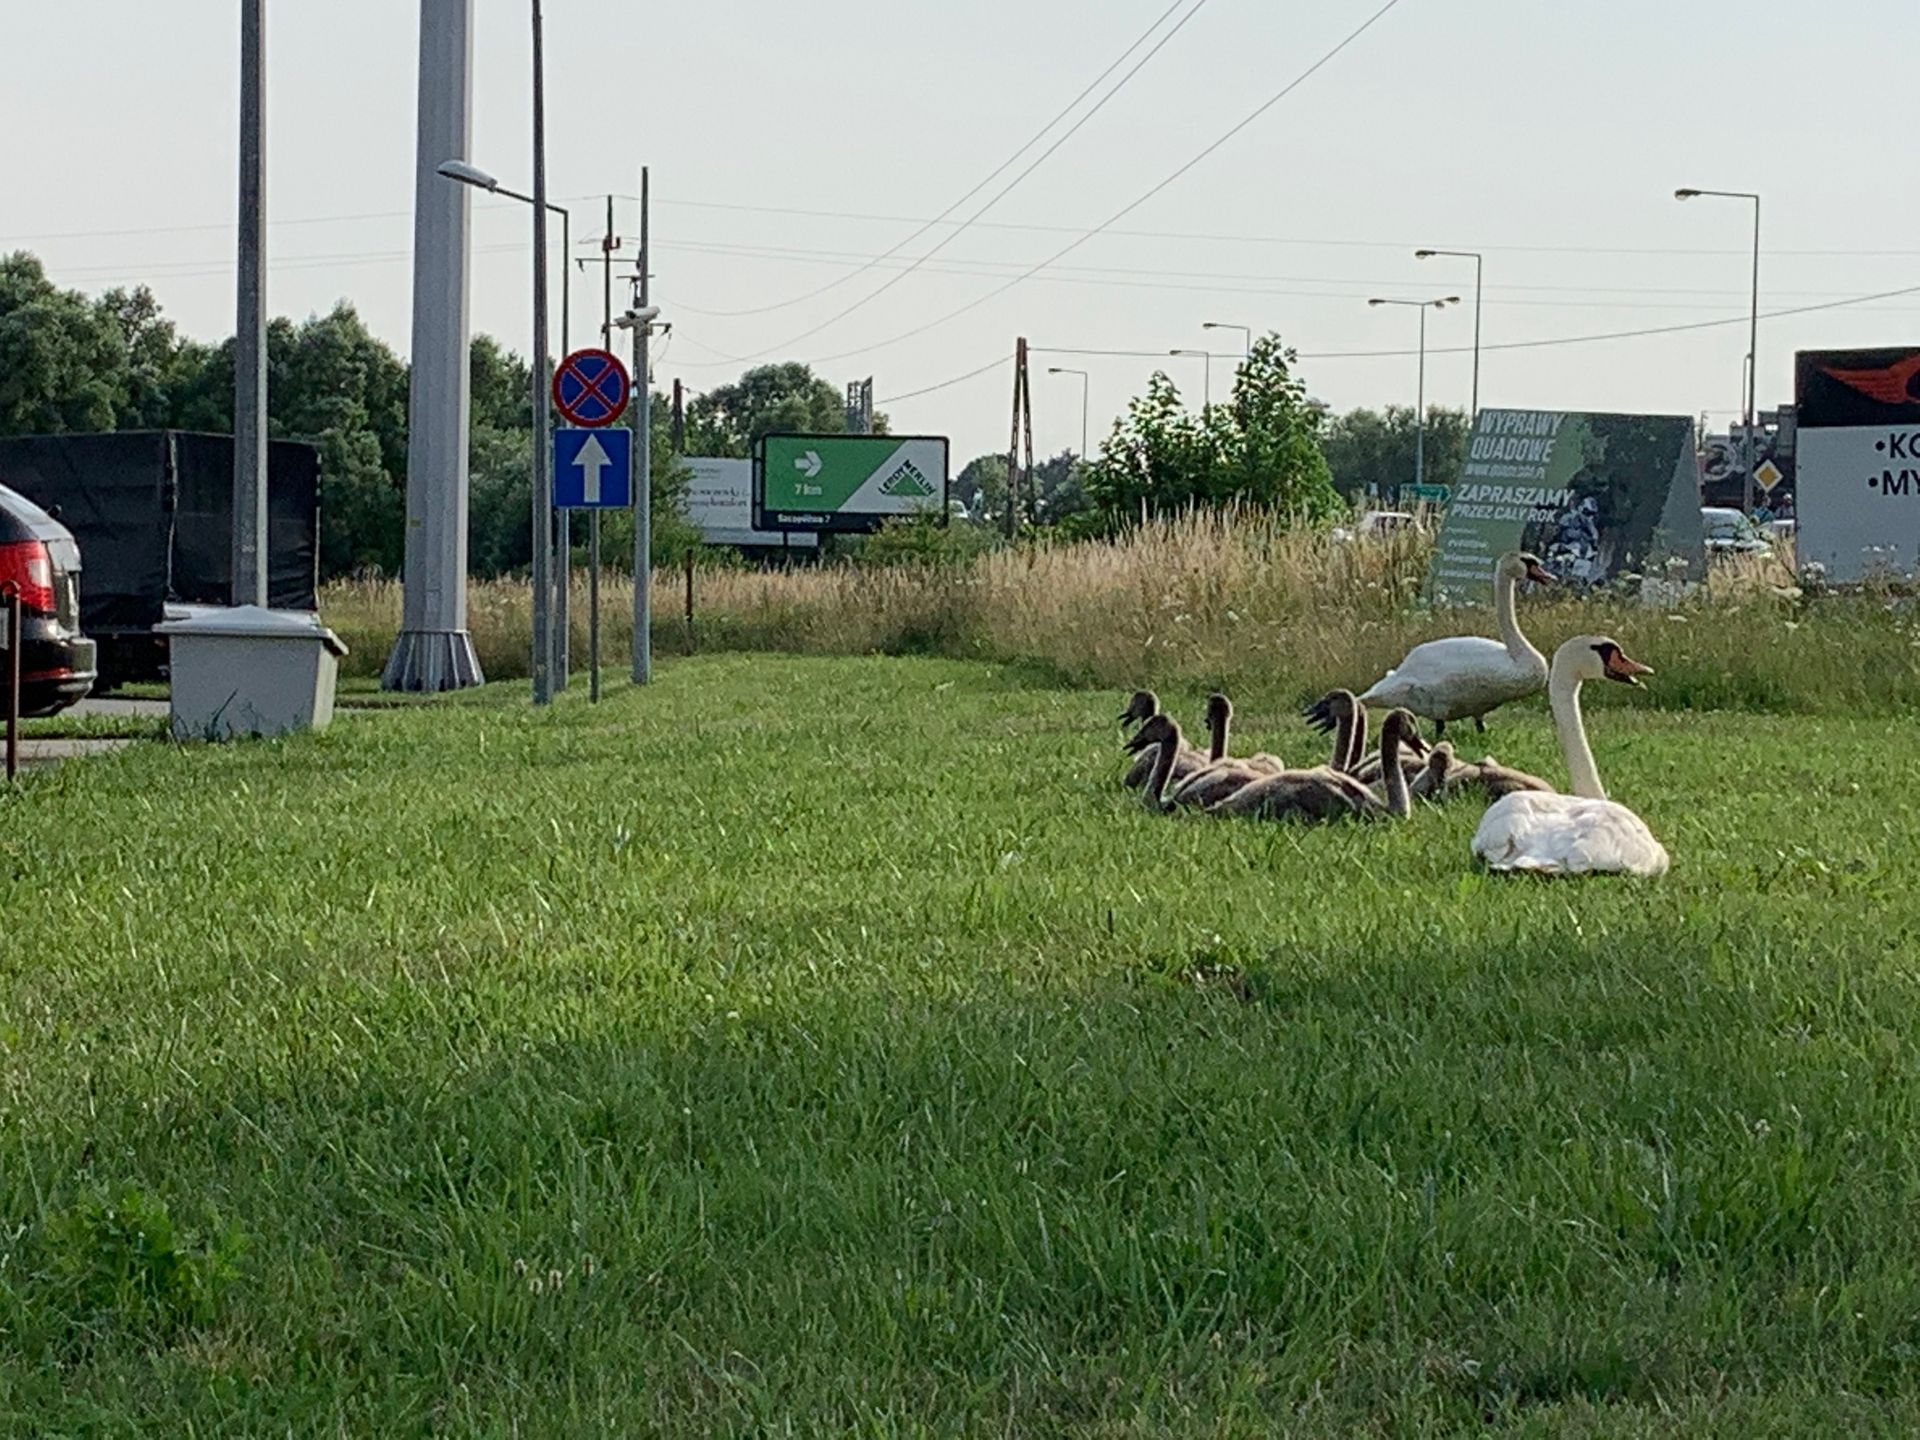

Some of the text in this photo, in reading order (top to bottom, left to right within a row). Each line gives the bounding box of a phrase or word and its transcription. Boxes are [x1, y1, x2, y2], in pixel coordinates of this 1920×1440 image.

[1480, 411, 1566, 436] WYPRAWY
[1471, 436, 1556, 462] QUADOWE
[877, 459, 936, 495] LEROY MERLIN
[794, 484, 822, 495] 7 km
[1456, 484, 1576, 507] ZAPRASZAMY
[1450, 503, 1494, 519] PRZEZ
[1527, 507, 1563, 523] ROK
